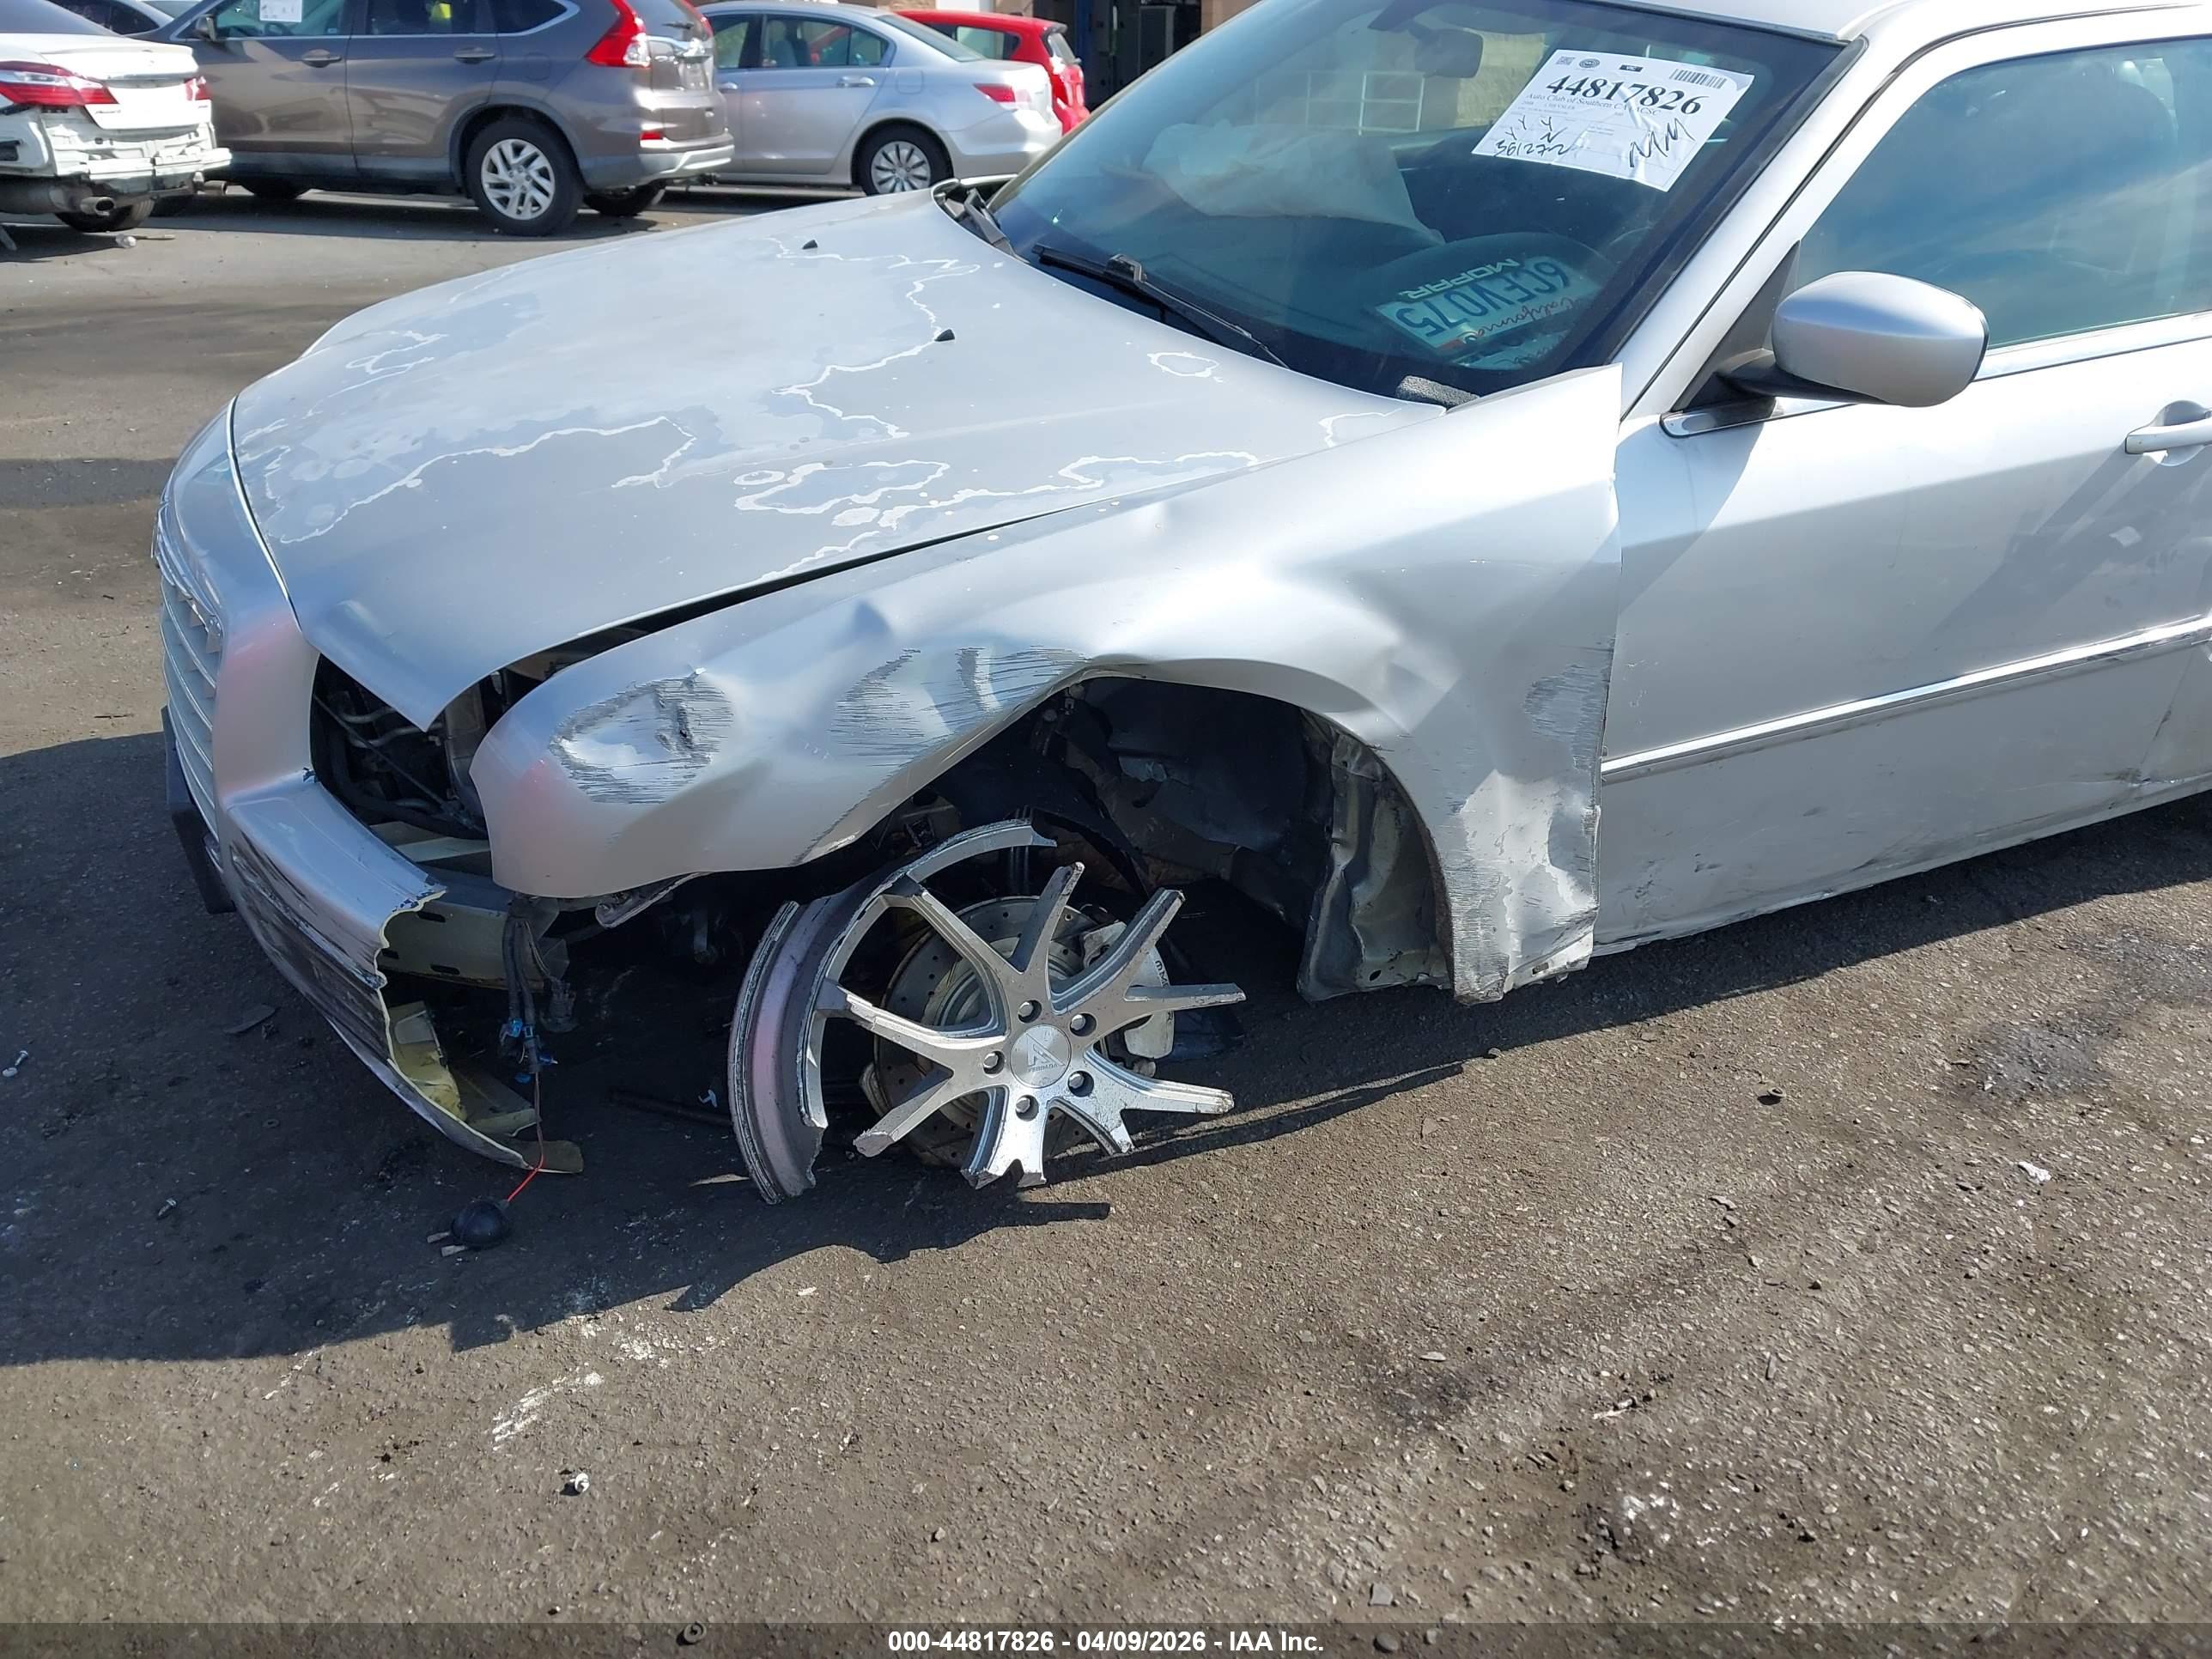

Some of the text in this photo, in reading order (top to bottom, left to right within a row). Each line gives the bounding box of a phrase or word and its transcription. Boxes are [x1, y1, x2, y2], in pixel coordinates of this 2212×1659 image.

[1526, 93, 1546, 101] Auto
[1547, 94, 1565, 103] Club
[1577, 97, 1613, 108] Southern
[1546, 75, 1710, 115] 44817826
[1398, 258, 1521, 299] MOPAR
[1395, 261, 1570, 337] 6CEV075
